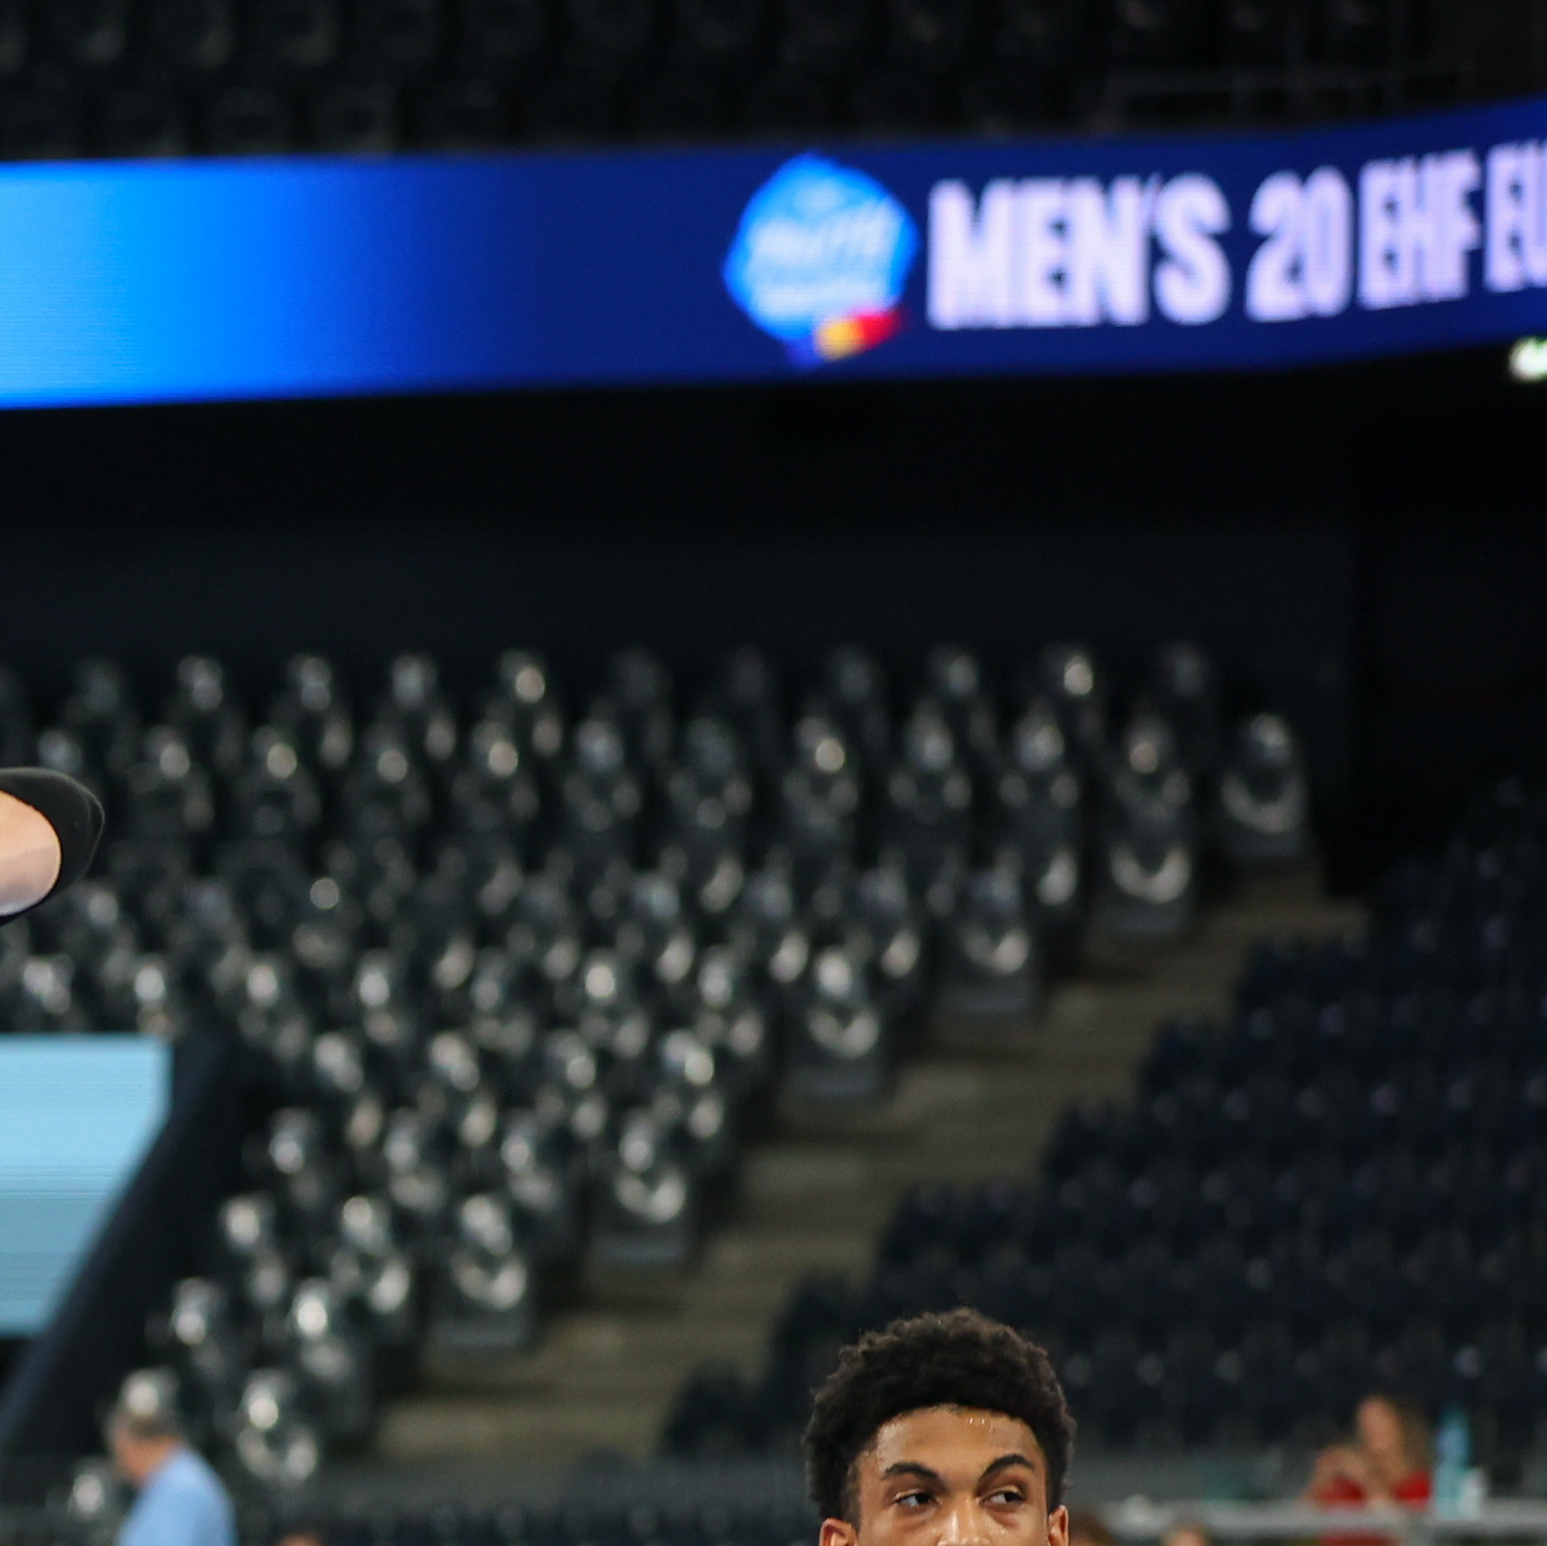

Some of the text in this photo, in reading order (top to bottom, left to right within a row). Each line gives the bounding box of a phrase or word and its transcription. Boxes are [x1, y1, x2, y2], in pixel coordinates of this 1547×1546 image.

[926, 170, 1231, 331] MEN'S
[1246, 163, 1354, 324] 20
[1357, 147, 1481, 311] EHF
